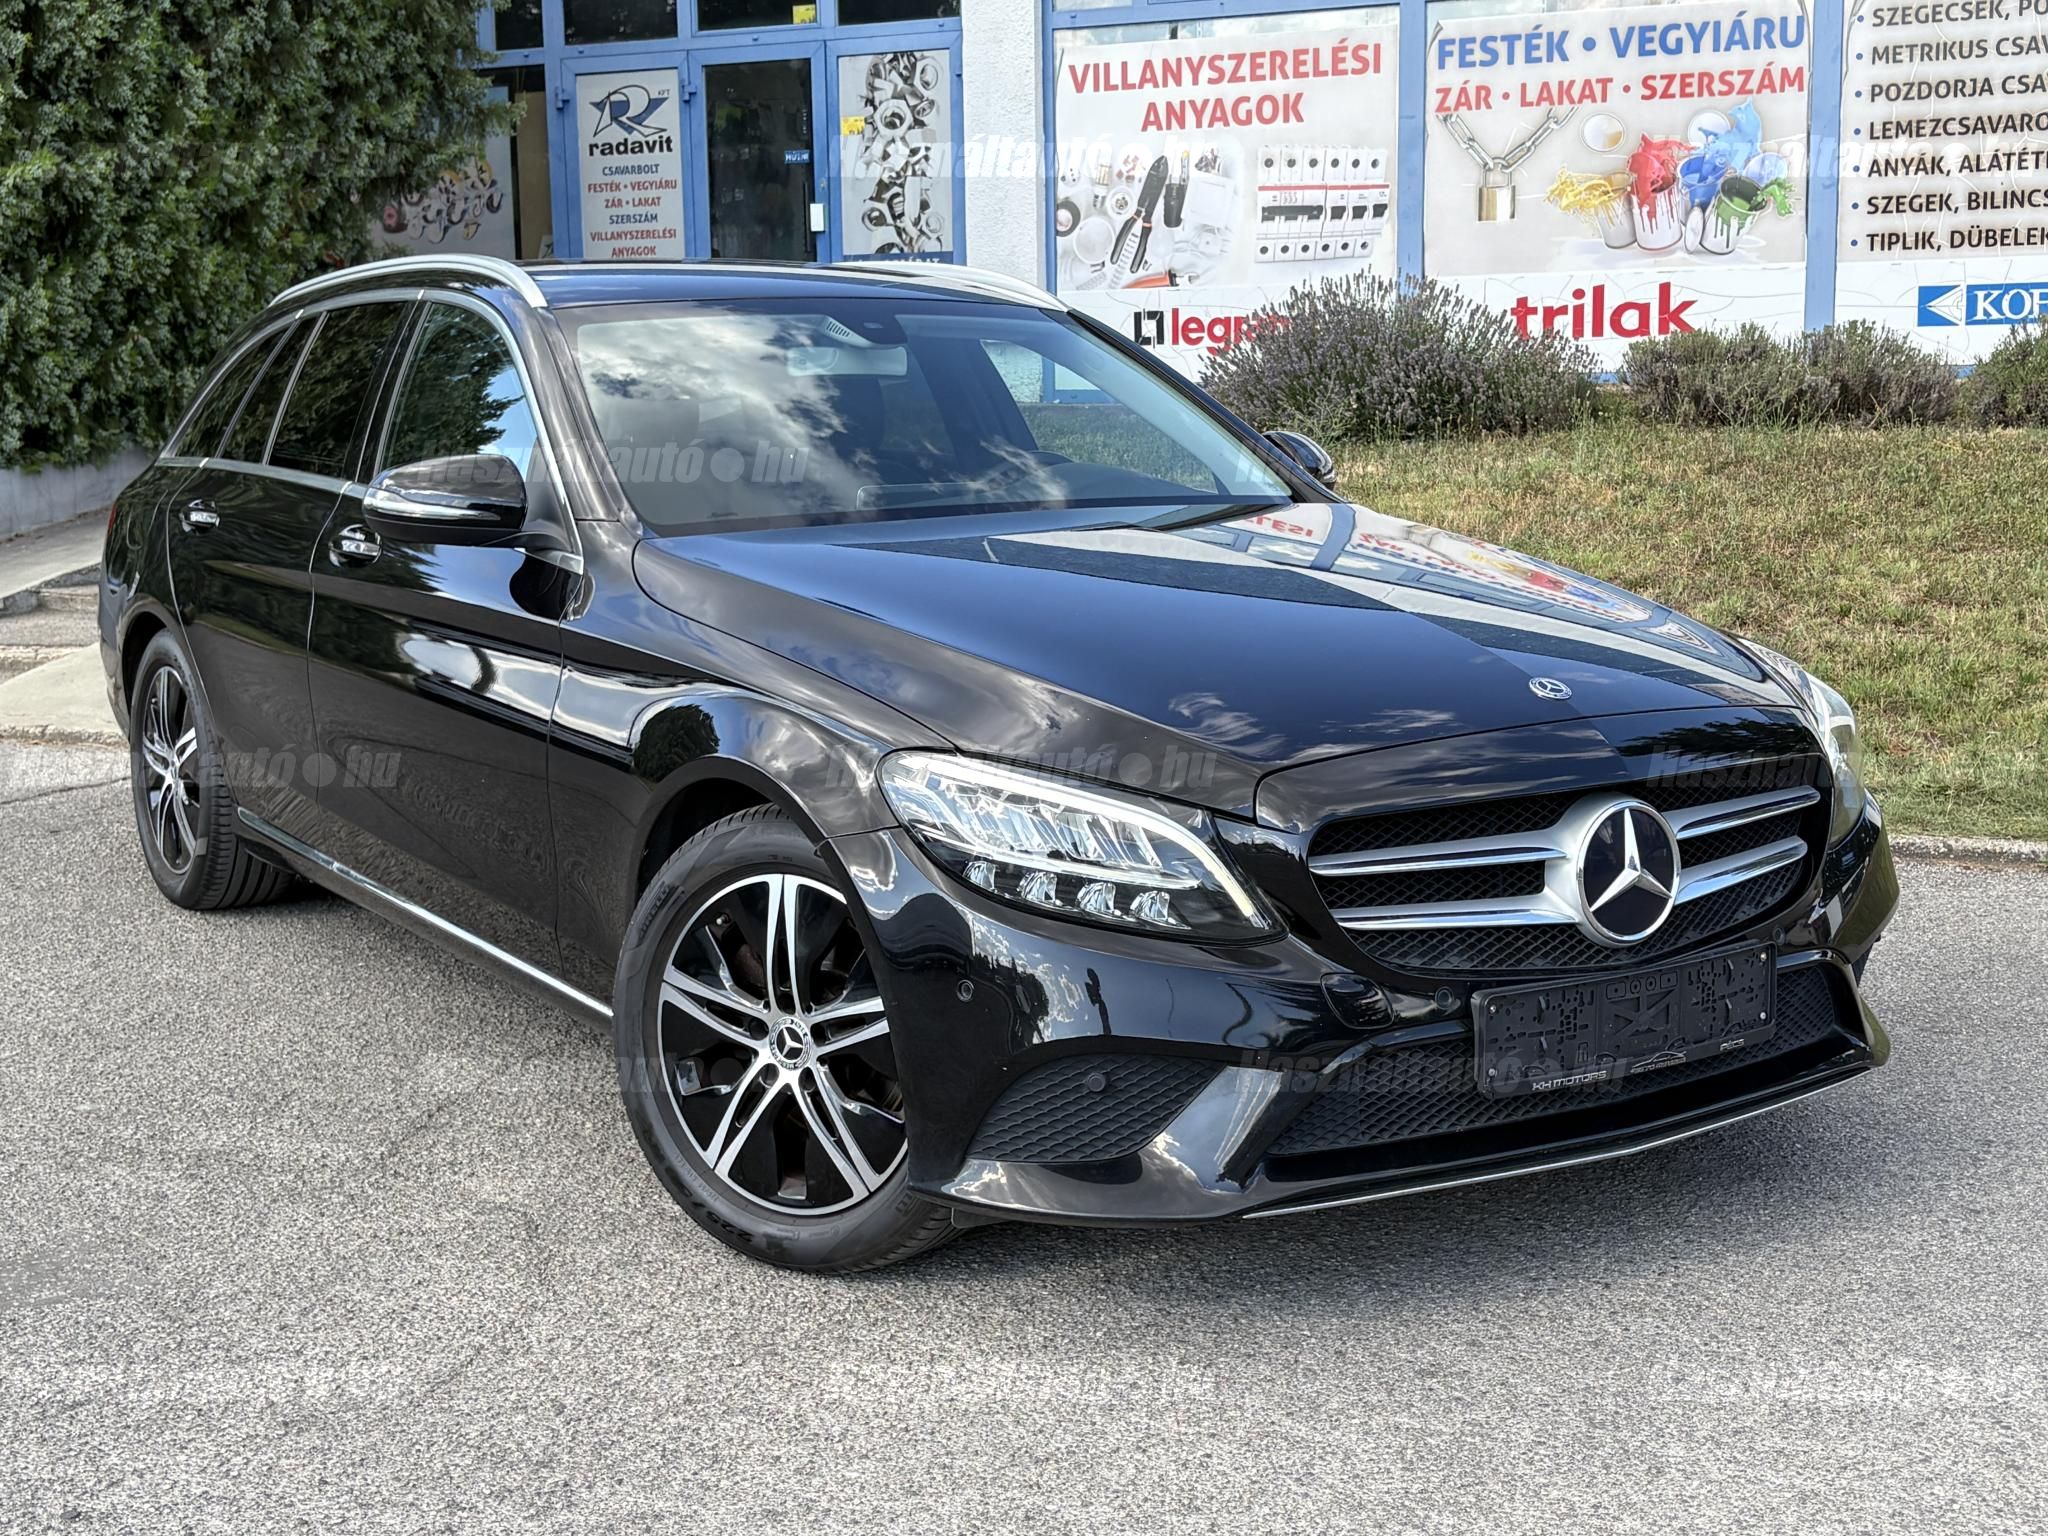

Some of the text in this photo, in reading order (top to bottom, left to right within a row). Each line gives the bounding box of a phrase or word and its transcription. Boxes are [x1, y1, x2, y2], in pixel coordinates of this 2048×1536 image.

[1872, 0, 2010, 27] SZEGECSEK,
[1437, 11, 1803, 70] FESTÉK VEGYIÁRU
[1871, 39, 1988, 65] METRIKUS
[1068, 38, 1382, 94] VILLANYSZERELÉSI
[1435, 62, 1804, 113] ZÁR LAKAT SZERSZÁM
[1870, 77, 1994, 102] POZDORJA
[1141, 93, 1305, 132] ANYAGOK
[1869, 110, 2048, 141] LEMEZCSAVARO
[588, 135, 673, 157] radavit
[602, 163, 660, 176] CSAVARBOLT
[1868, 147, 2048, 178] ANYÁK, ALÁTÉT
[588, 178, 677, 193] FESTÉK VEGYIÁRU
[604, 197, 661, 209] ZÁR LAKAT
[1867, 192, 1959, 215] SZEGEK,
[609, 211, 658, 225] SZERSZÁM
[590, 227, 677, 242] VILLANYSZERELÉSI
[1866, 230, 1941, 252] TIPLIK,
[611, 245, 656, 258] ANYAGOK
[1510, 282, 1698, 341] trilak
[1171, 308, 1292, 356] legr
